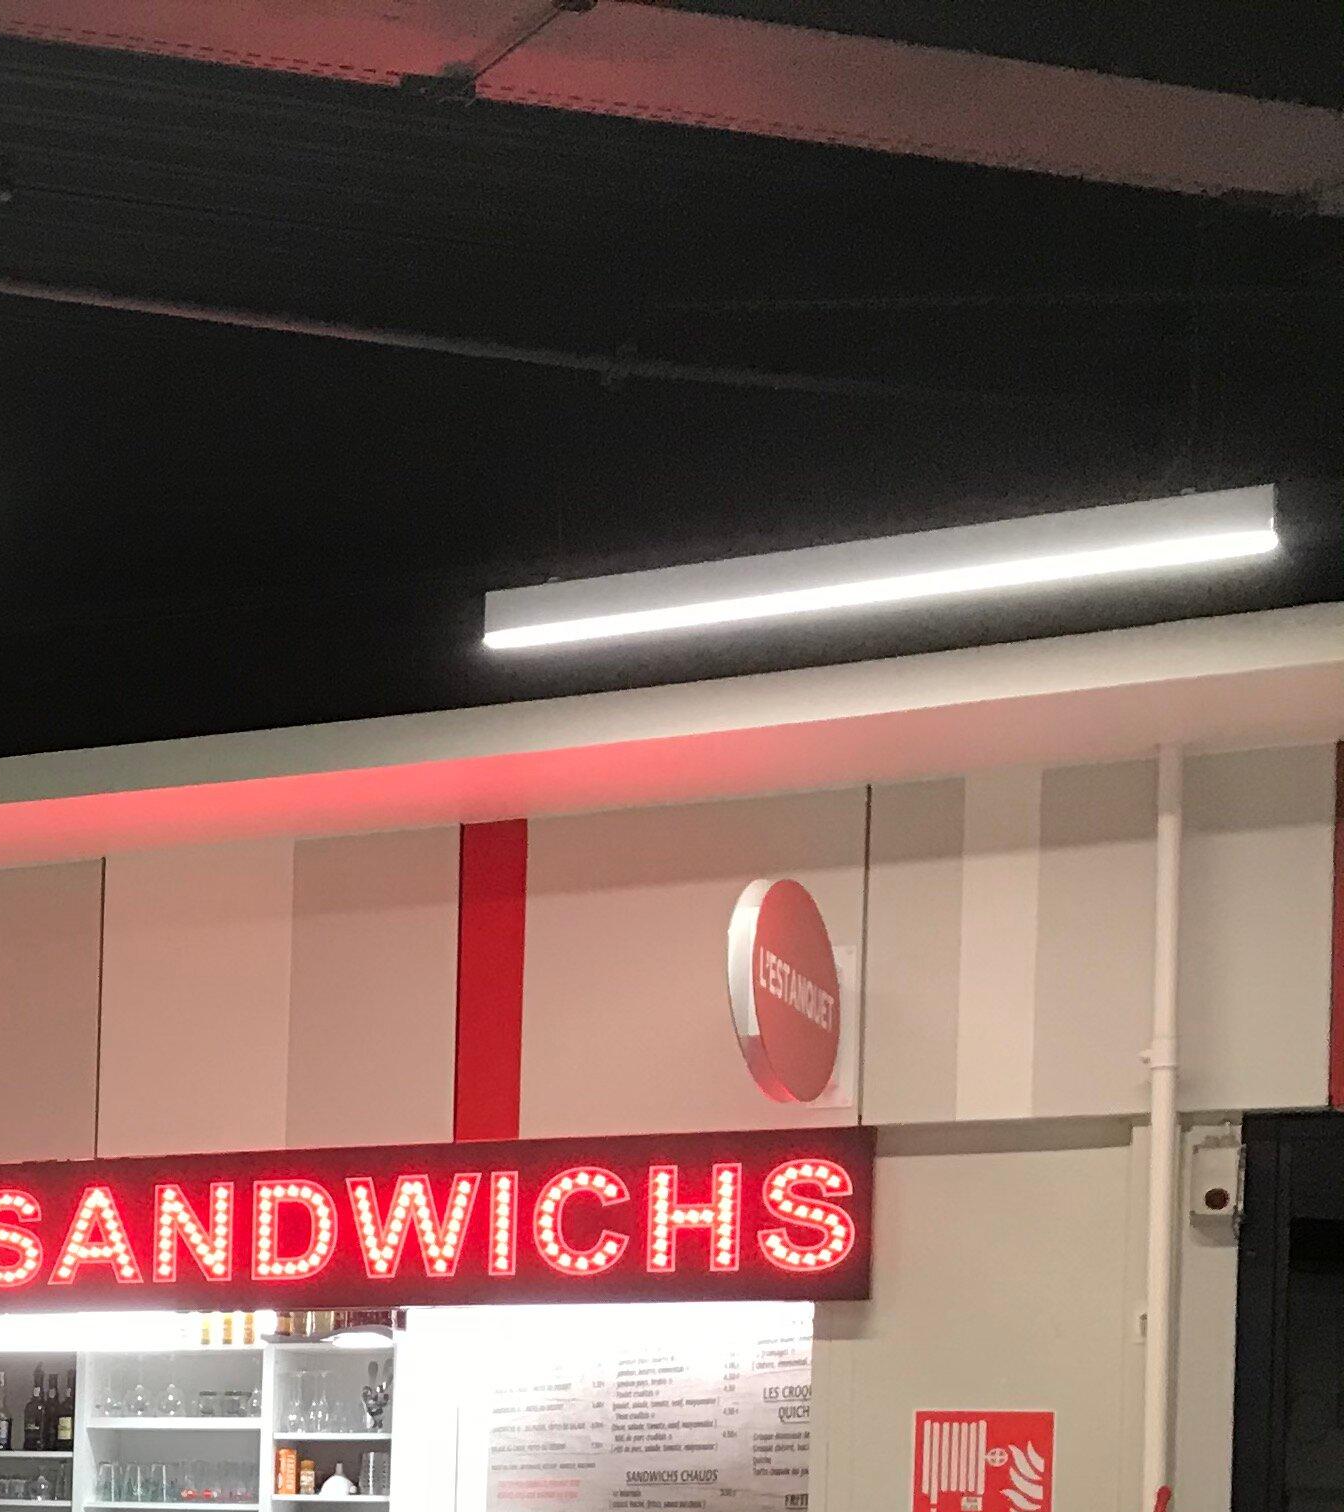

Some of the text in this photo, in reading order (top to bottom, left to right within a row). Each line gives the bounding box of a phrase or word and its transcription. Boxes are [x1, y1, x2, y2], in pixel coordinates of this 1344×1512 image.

[759, 945, 835, 1033] L'ESTANQUET
[763, 1387, 779, 1399] LES
[626, 1469, 719, 1483] SANDWICHS CHAUDS
